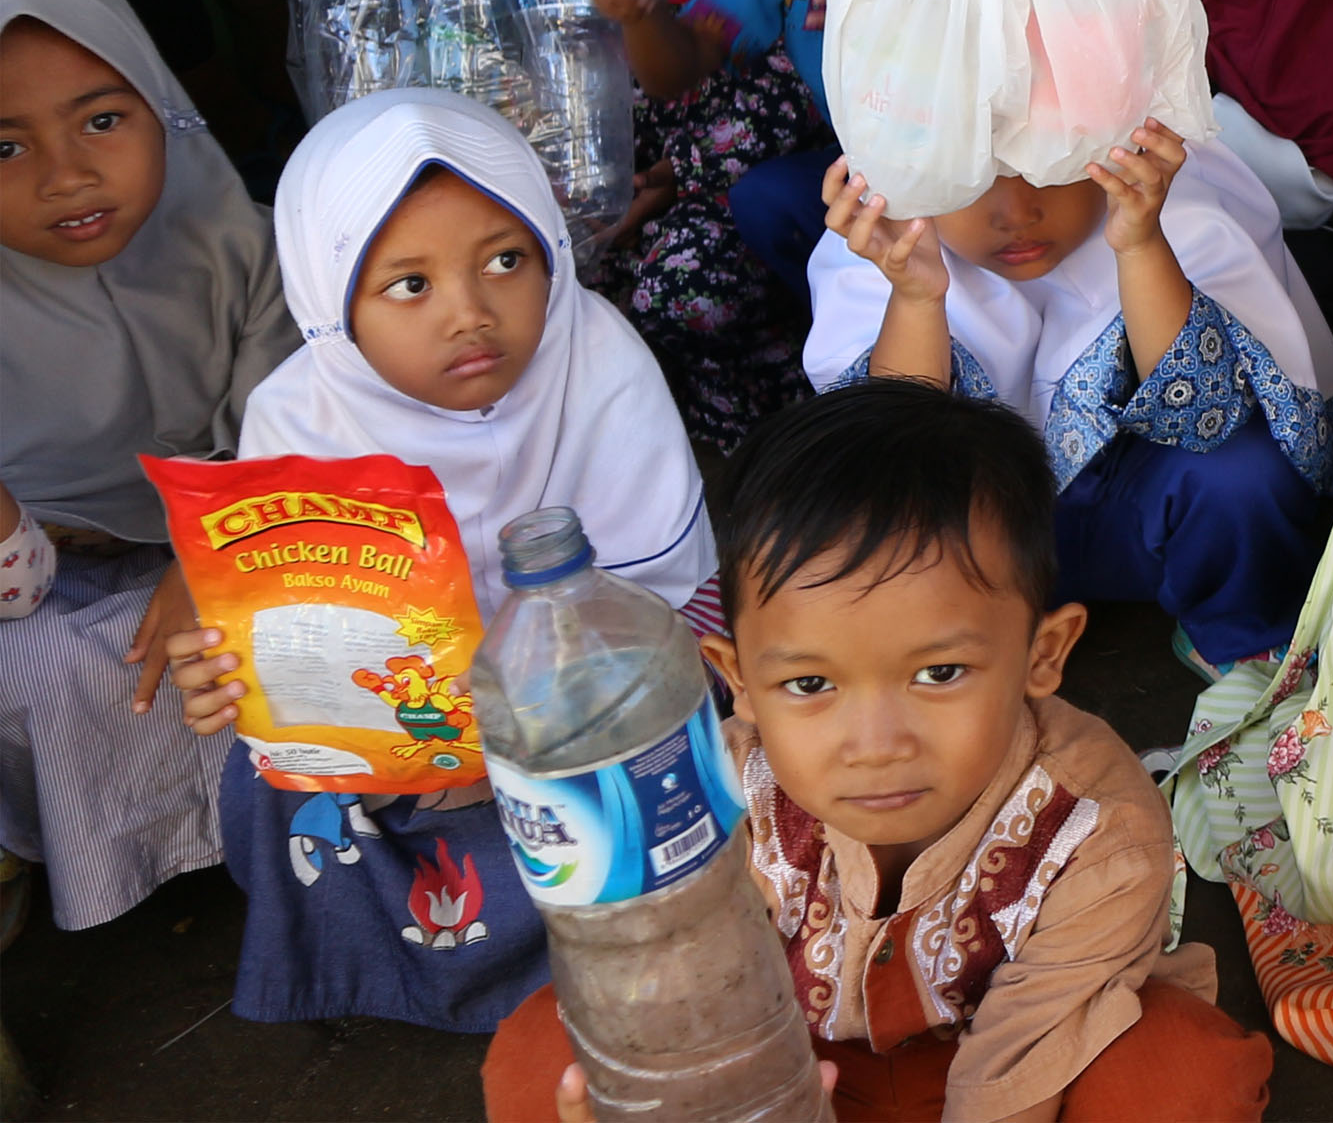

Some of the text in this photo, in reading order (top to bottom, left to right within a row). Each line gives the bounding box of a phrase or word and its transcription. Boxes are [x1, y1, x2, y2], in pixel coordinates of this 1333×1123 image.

[214, 495, 416, 538] CHAMP
[234, 541, 414, 580] Chicken Ball
[282, 572, 390, 598] Bakso Ayam
[496, 786, 578, 851] QUA
